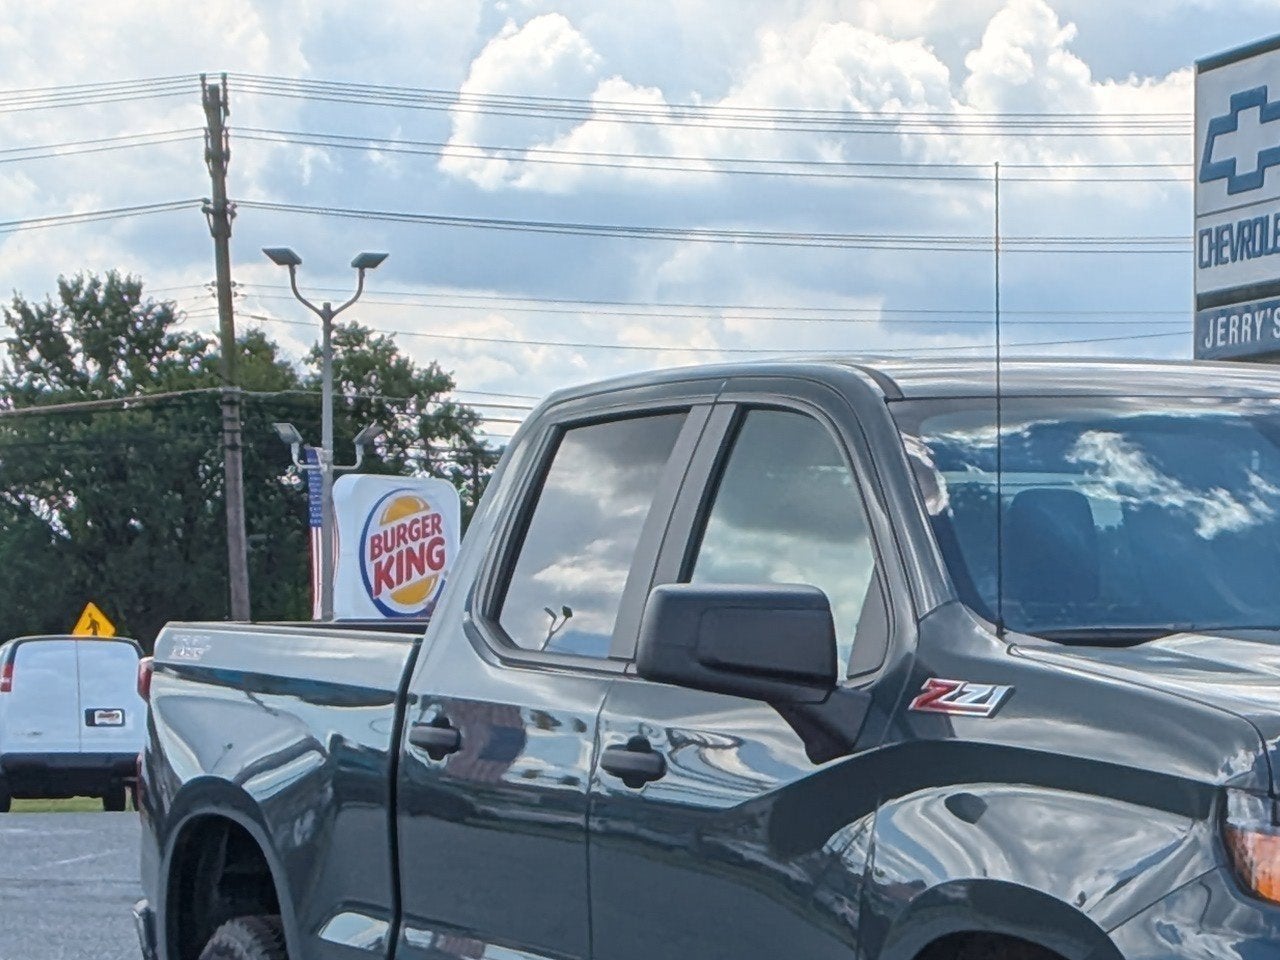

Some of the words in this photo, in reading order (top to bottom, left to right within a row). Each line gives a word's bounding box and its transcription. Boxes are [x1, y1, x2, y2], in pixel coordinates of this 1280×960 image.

[370, 513, 442, 562] BURGER
[373, 536, 445, 598] KING
[908, 678, 1015, 717] Z71
